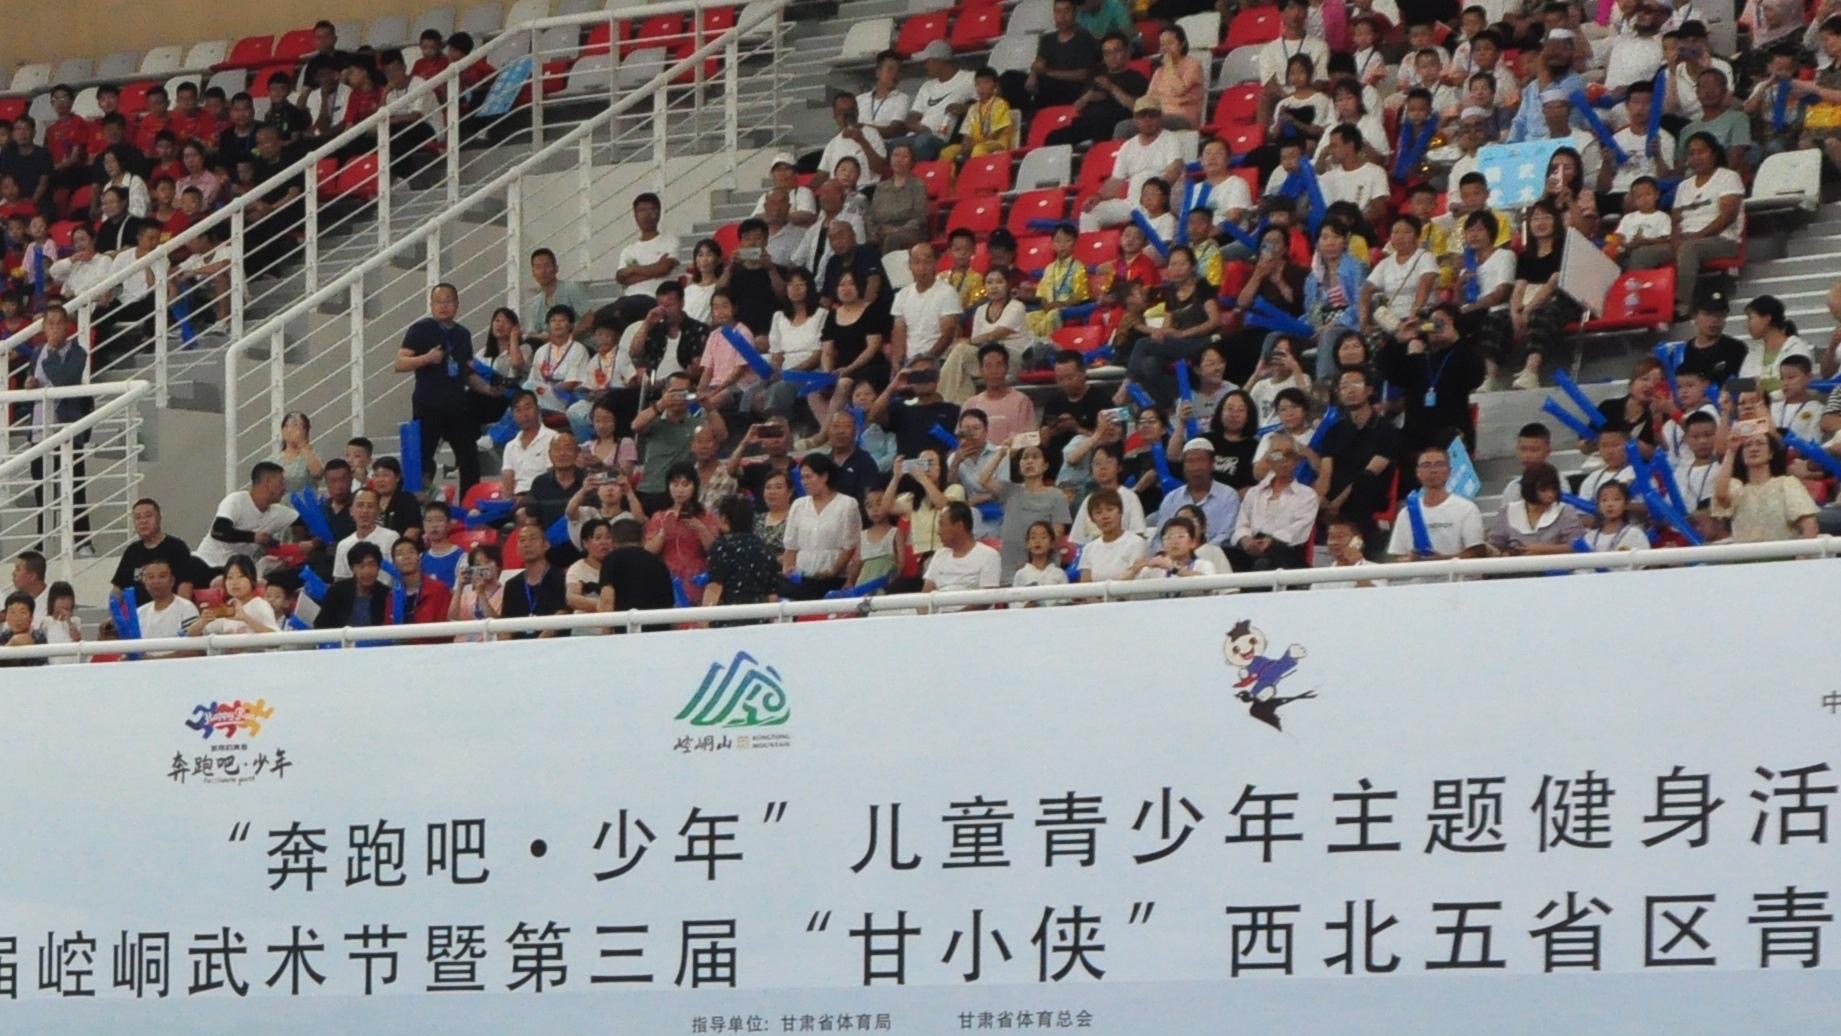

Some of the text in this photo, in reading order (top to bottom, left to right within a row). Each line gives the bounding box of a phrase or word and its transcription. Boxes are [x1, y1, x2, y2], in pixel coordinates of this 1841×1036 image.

[780, 1013, 892, 1032] 甘肃省体育局
[958, 1010, 1093, 1029] 甘肃省体育总会
